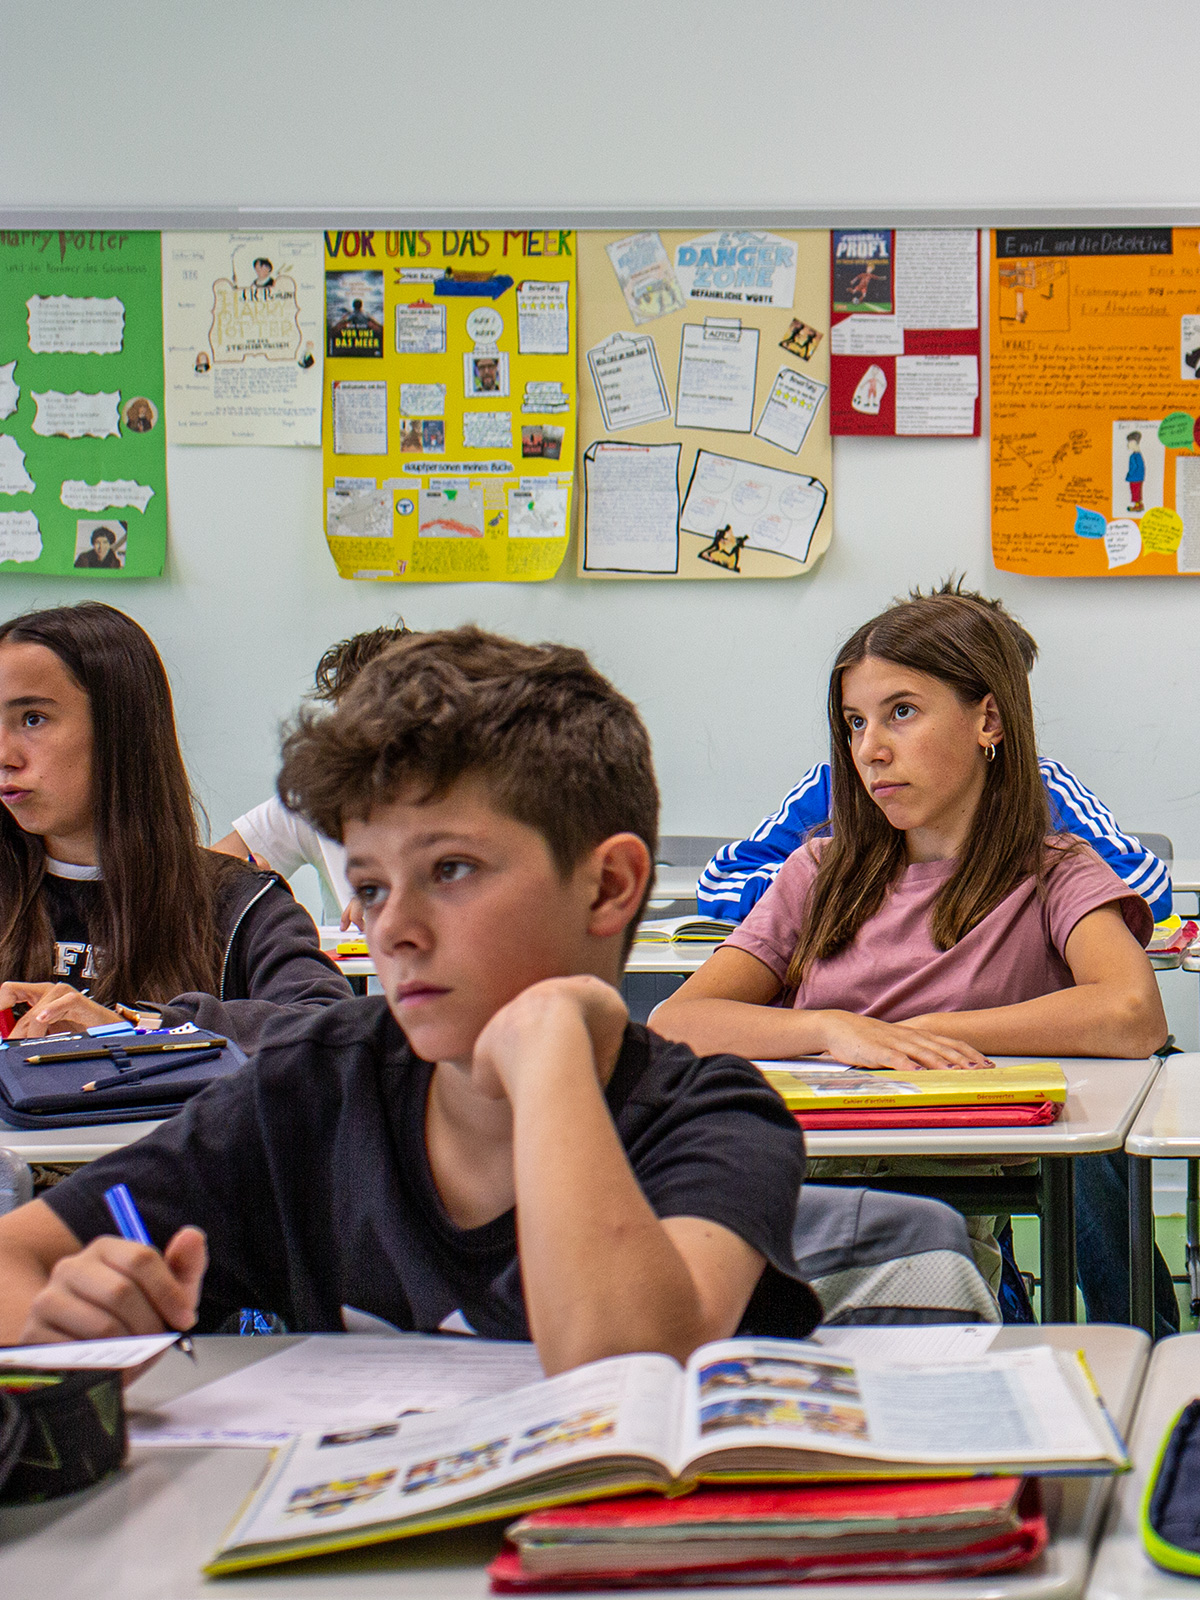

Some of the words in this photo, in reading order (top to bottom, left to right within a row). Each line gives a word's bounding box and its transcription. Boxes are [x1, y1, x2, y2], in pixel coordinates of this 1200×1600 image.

[59, 230, 129, 265] Potter
[323, 230, 376, 258] VOR
[385, 230, 431, 257] UNS
[442, 230, 490, 257] DAS
[503, 230, 572, 257] MEER
[836, 239, 889, 258] PROFI
[1101, 232, 1169, 251] Detektive
[678, 245, 794, 268] DANGER
[693, 266, 774, 289] ZONE
[335, 338, 353, 348] DAS
[354, 338, 380, 348] MEER
[341, 329, 357, 338] VOR
[358, 329, 374, 338] UNS
[864, 1097, 896, 1105] d'activités
[976, 1093, 1015, 1101] Découvertes
